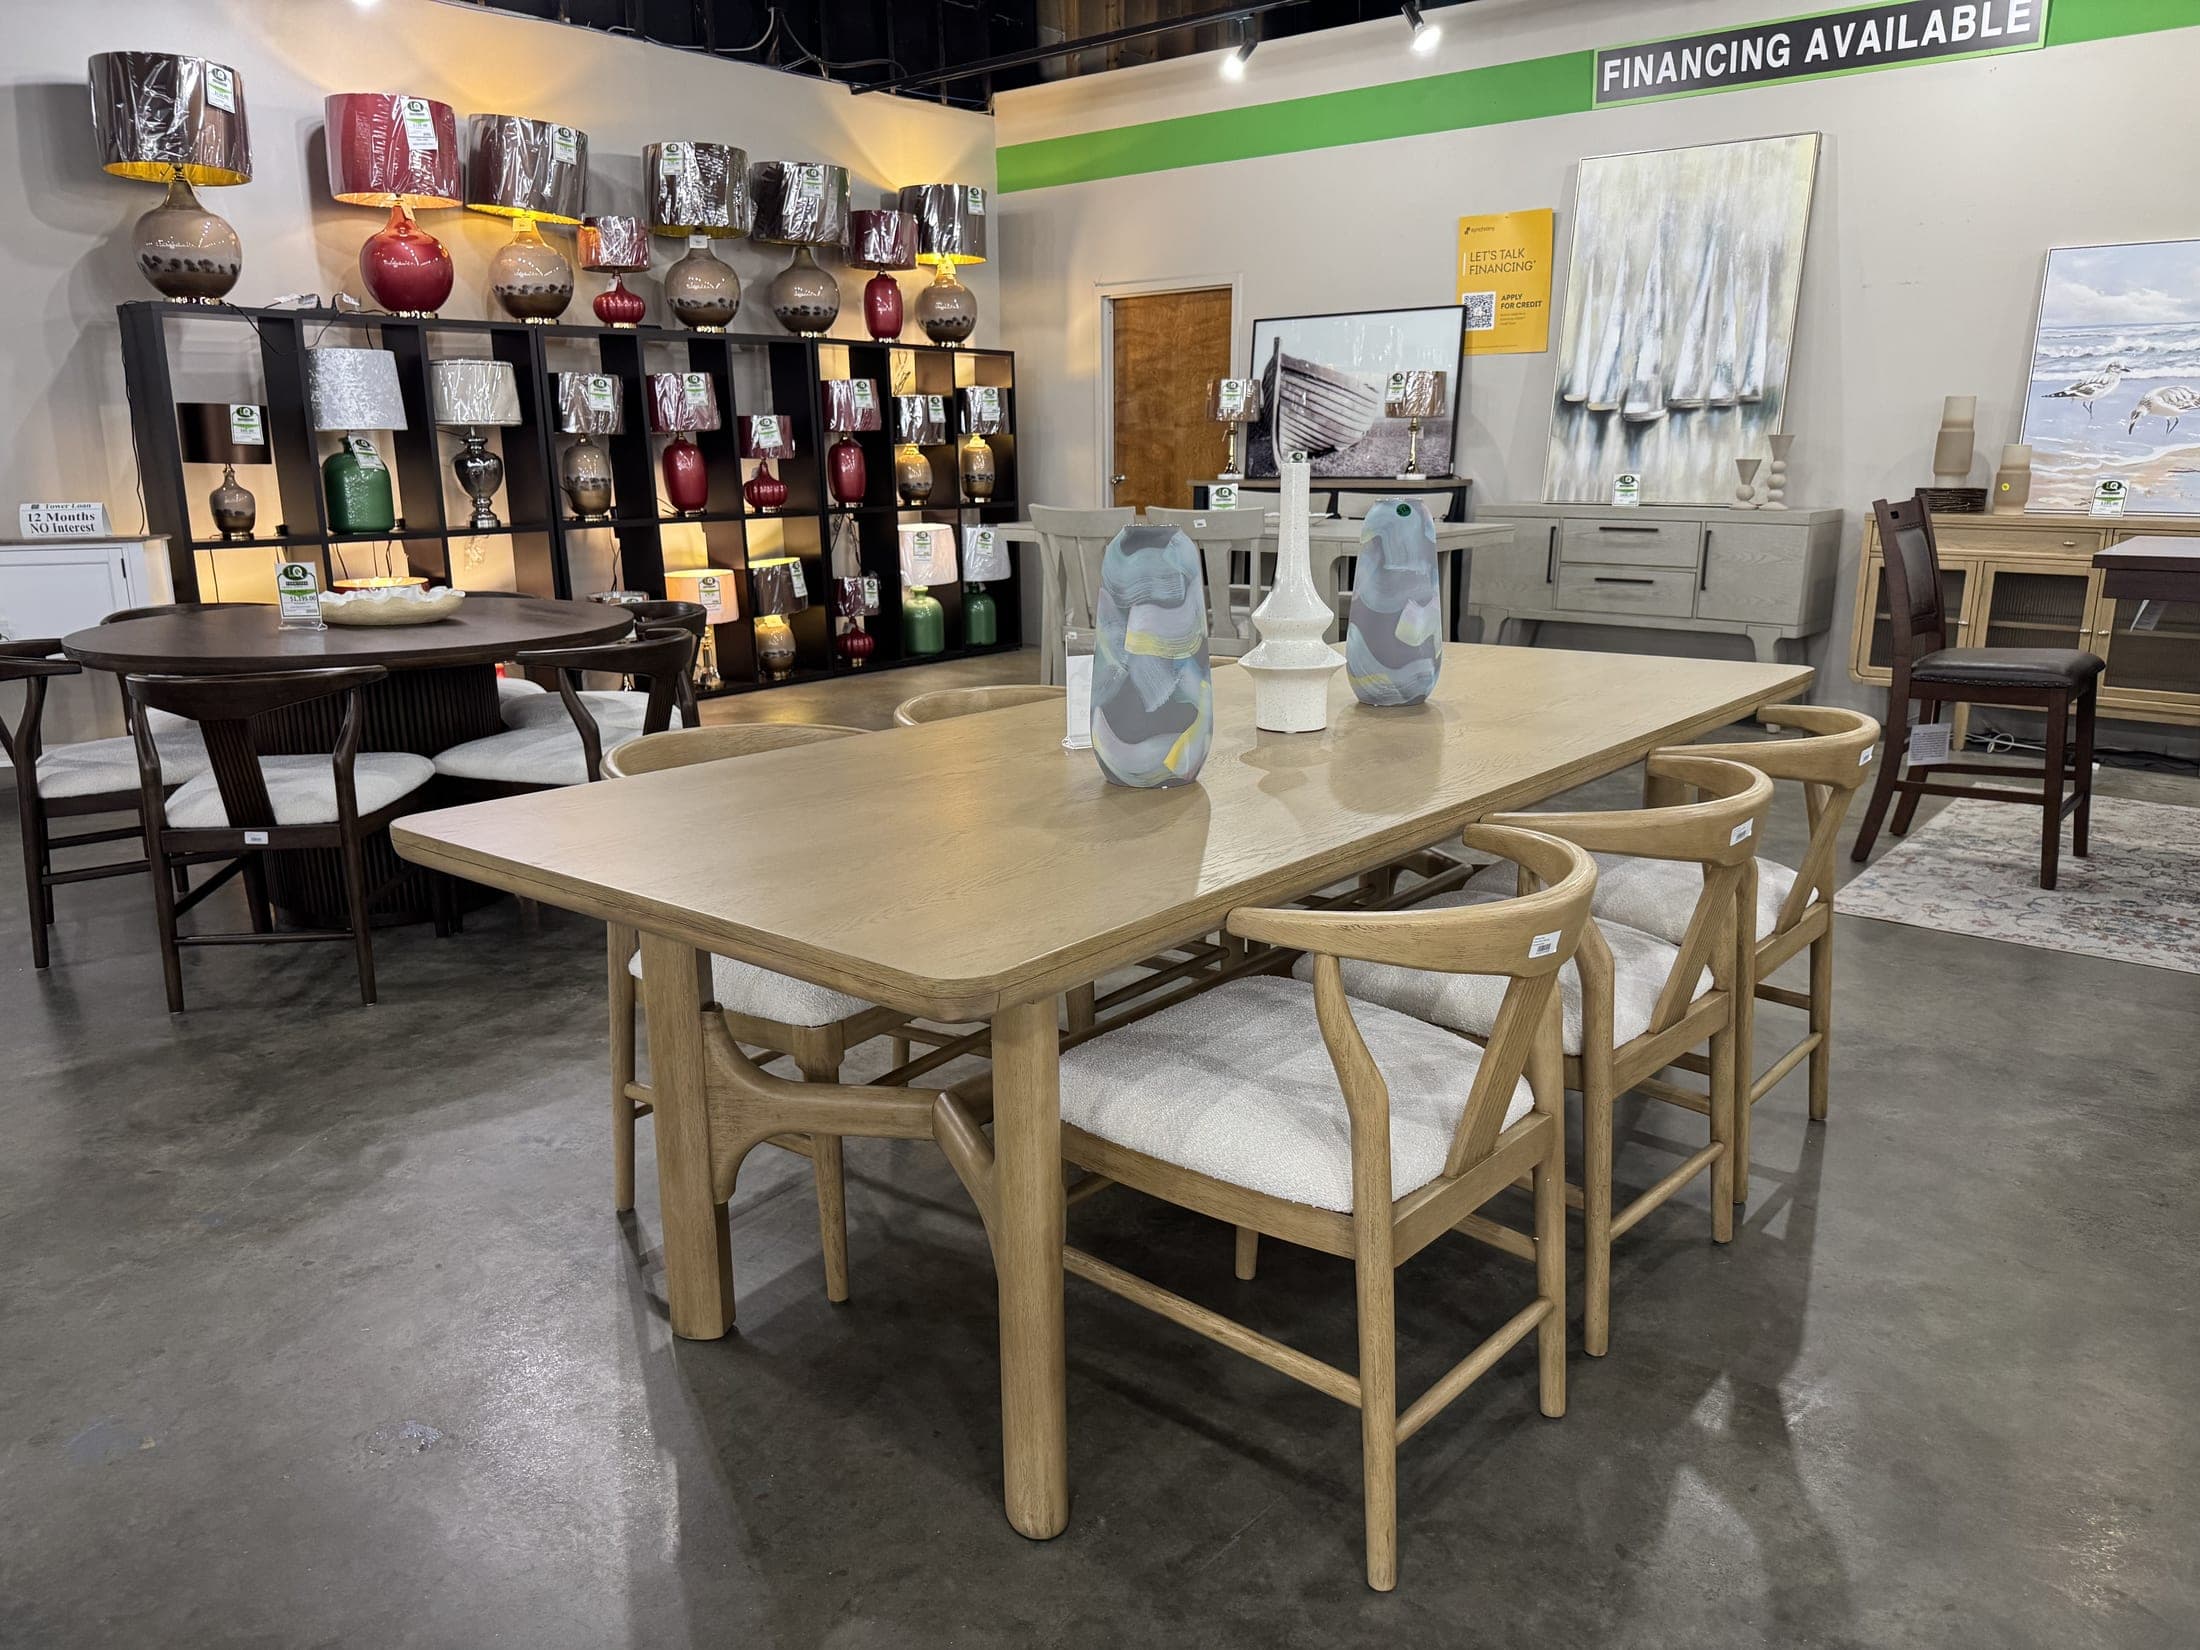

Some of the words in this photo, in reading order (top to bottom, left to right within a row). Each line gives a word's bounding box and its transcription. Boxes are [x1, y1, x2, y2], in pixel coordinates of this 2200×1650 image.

[1603, 33, 1790, 92] FINANCING
[1805, 0, 2031, 63] AVAILABLE
[1470, 250, 1497, 262] LET'S
[1500, 248, 1524, 260] TALK
[1500, 302, 1514, 310] FOR
[1516, 300, 1542, 309] CREDIT
[28, 513, 42, 522] 12
[46, 512, 96, 522] Months
[30, 523, 50, 533] NO
[53, 522, 96, 533] Interest
